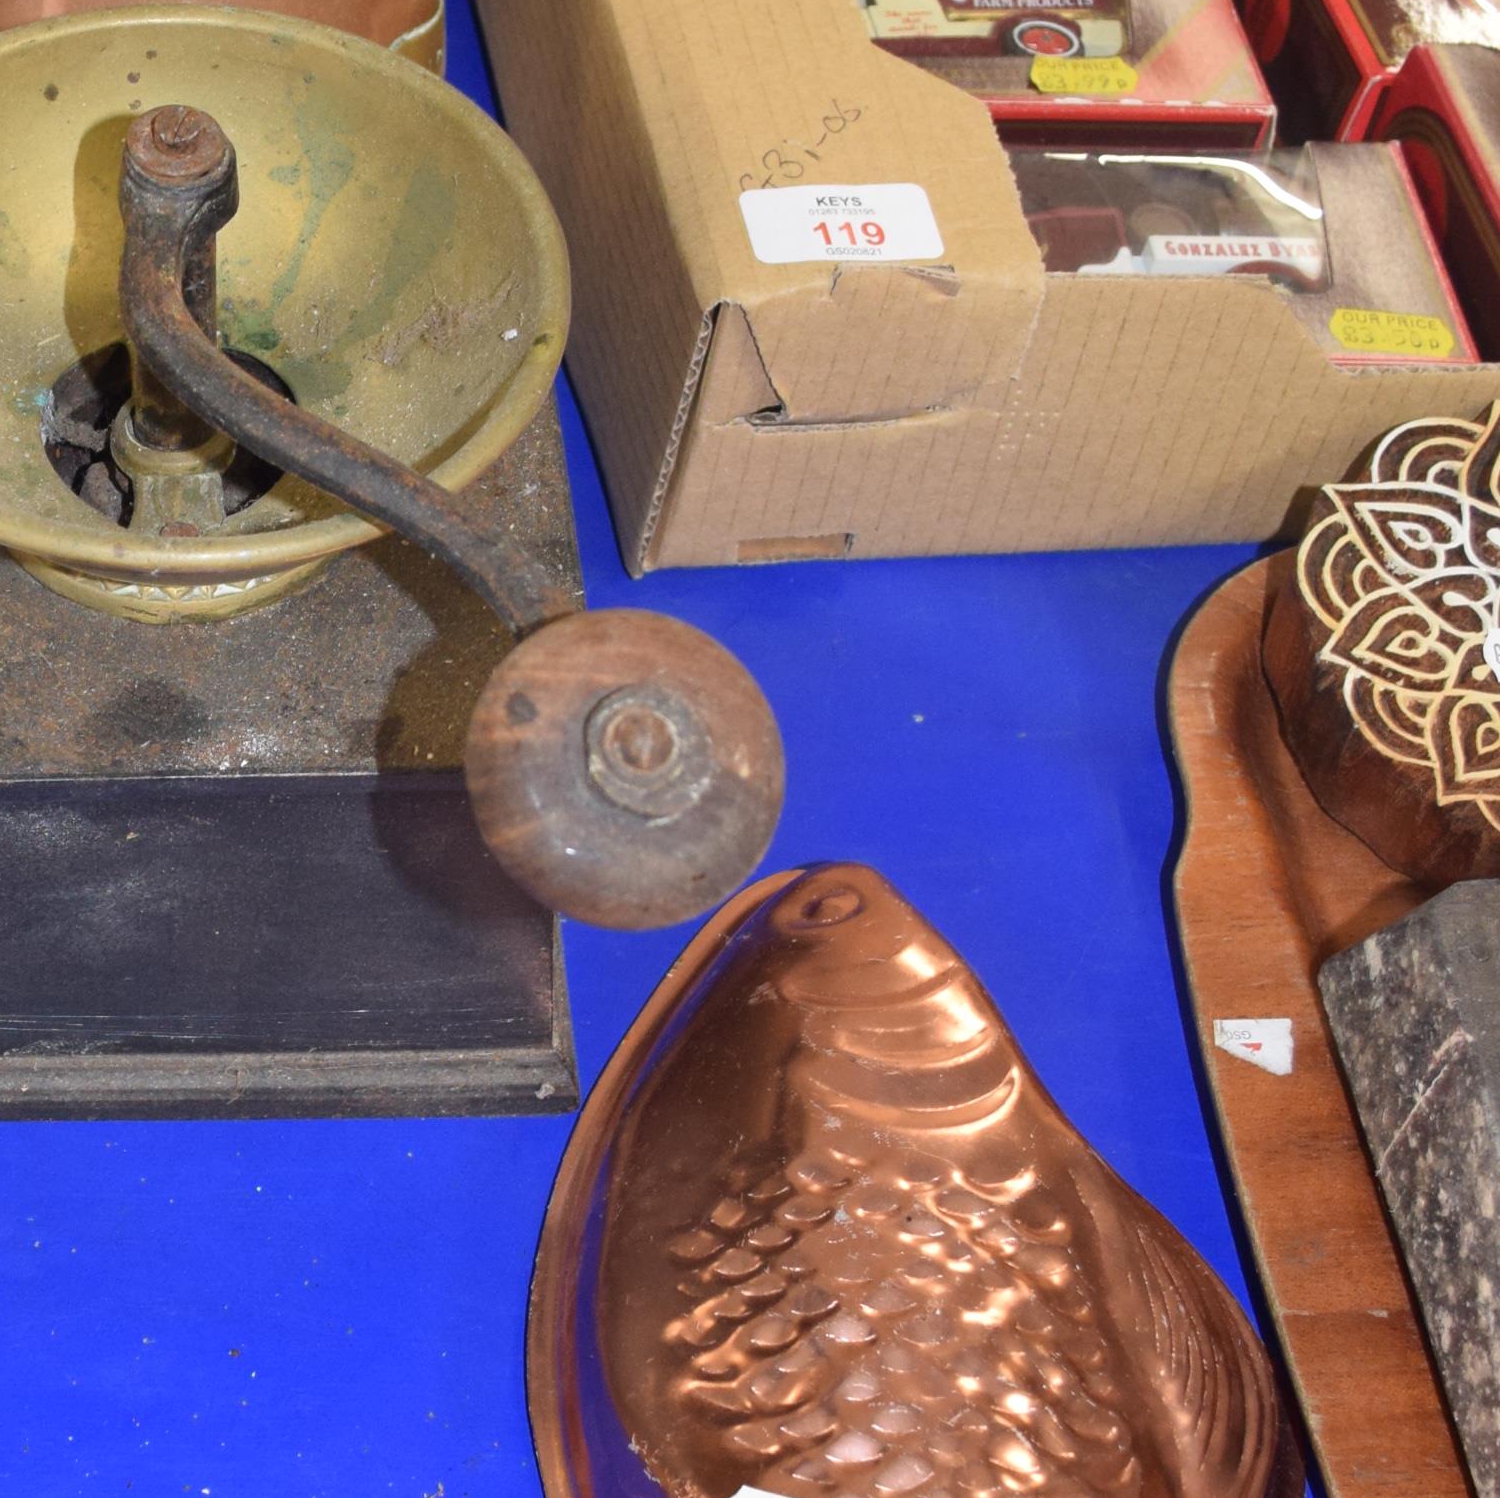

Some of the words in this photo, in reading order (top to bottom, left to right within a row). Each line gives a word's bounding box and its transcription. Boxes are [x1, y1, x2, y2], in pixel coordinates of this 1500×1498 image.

[815, 196, 862, 207] KEYS
[813, 221, 885, 246] 119
[1164, 240, 1261, 257] GONZALEZ
[1341, 311, 1379, 324] OUR
[1386, 315, 1439, 331] PRICE
